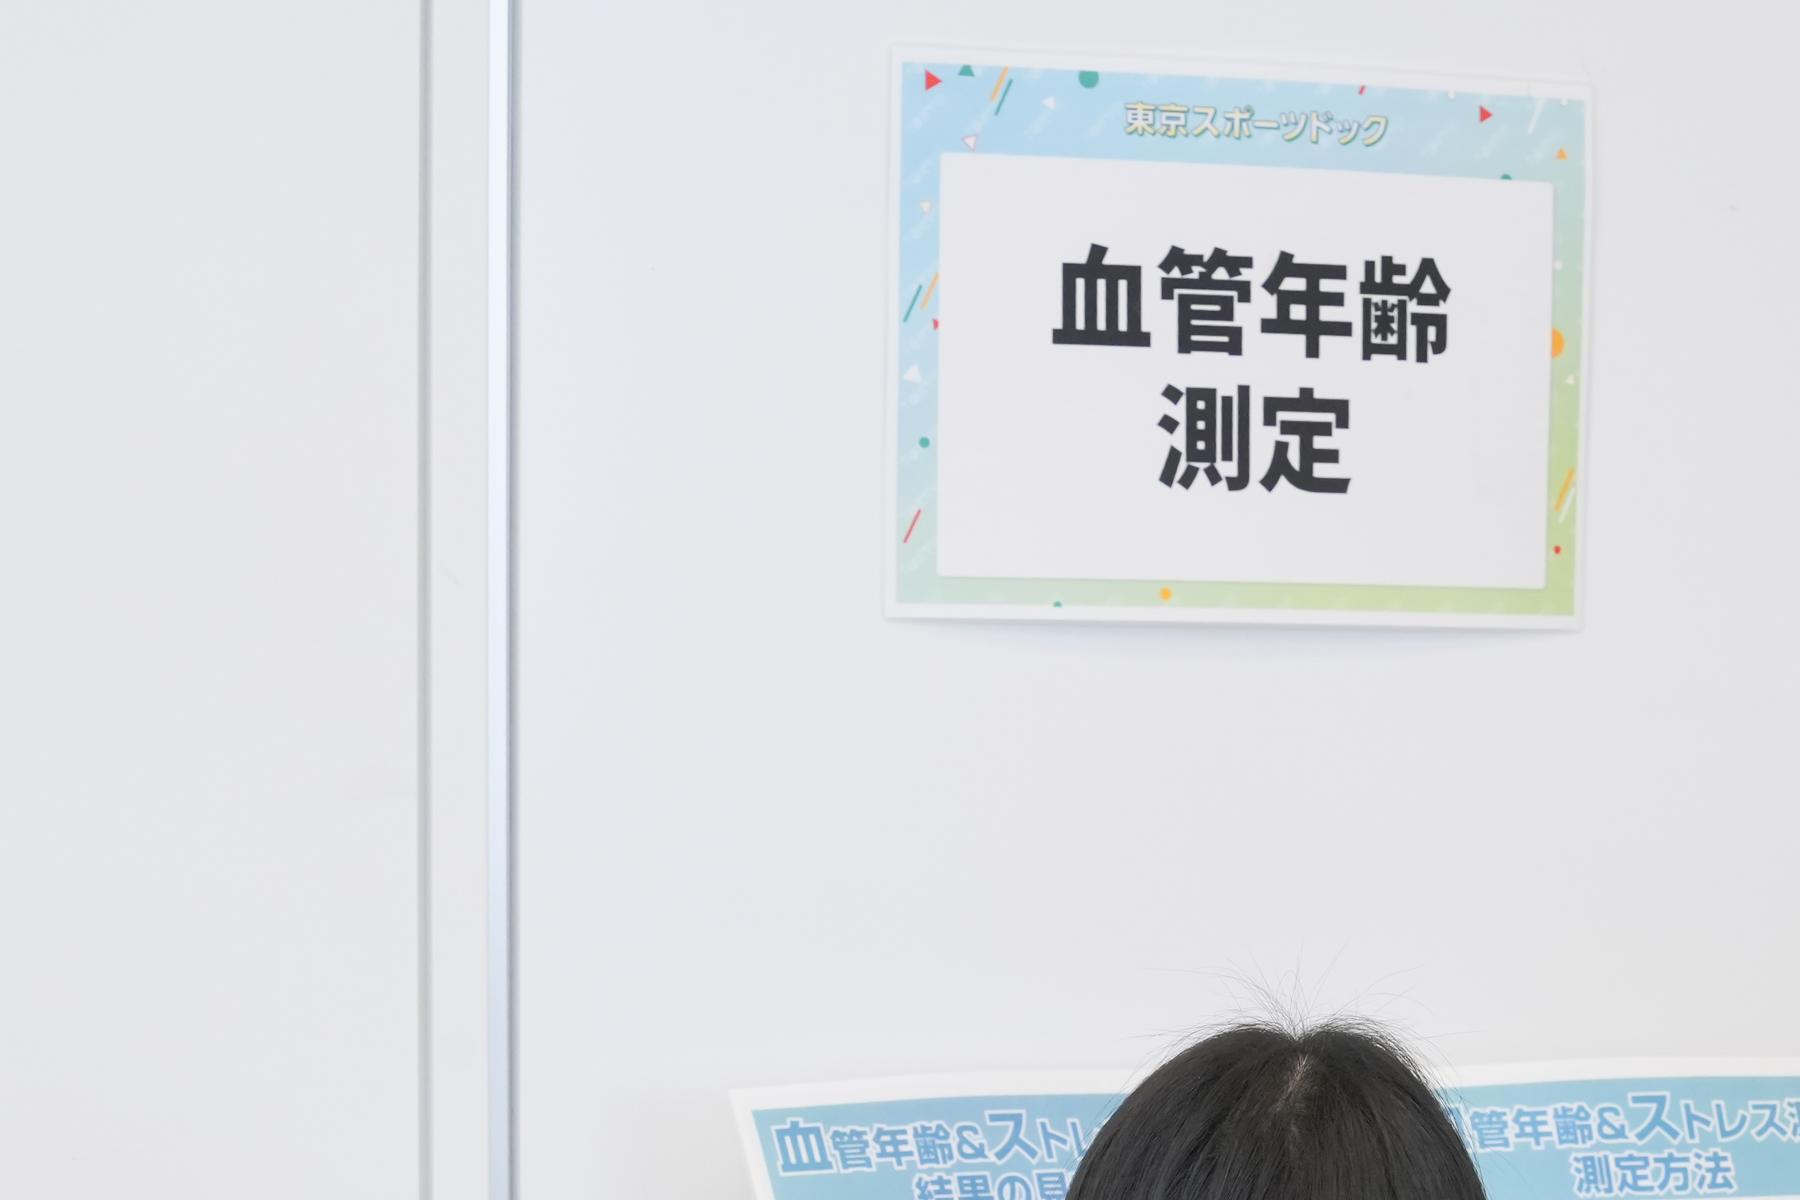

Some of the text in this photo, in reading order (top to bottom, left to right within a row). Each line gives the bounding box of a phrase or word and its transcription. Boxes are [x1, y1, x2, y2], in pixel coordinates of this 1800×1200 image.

[1123, 100, 1389, 148] 東京スポーツドック
[1052, 242, 1452, 364] 血管年齢
[1157, 384, 1353, 495] 測定
[1572, 1152, 1737, 1194] 測定方法
